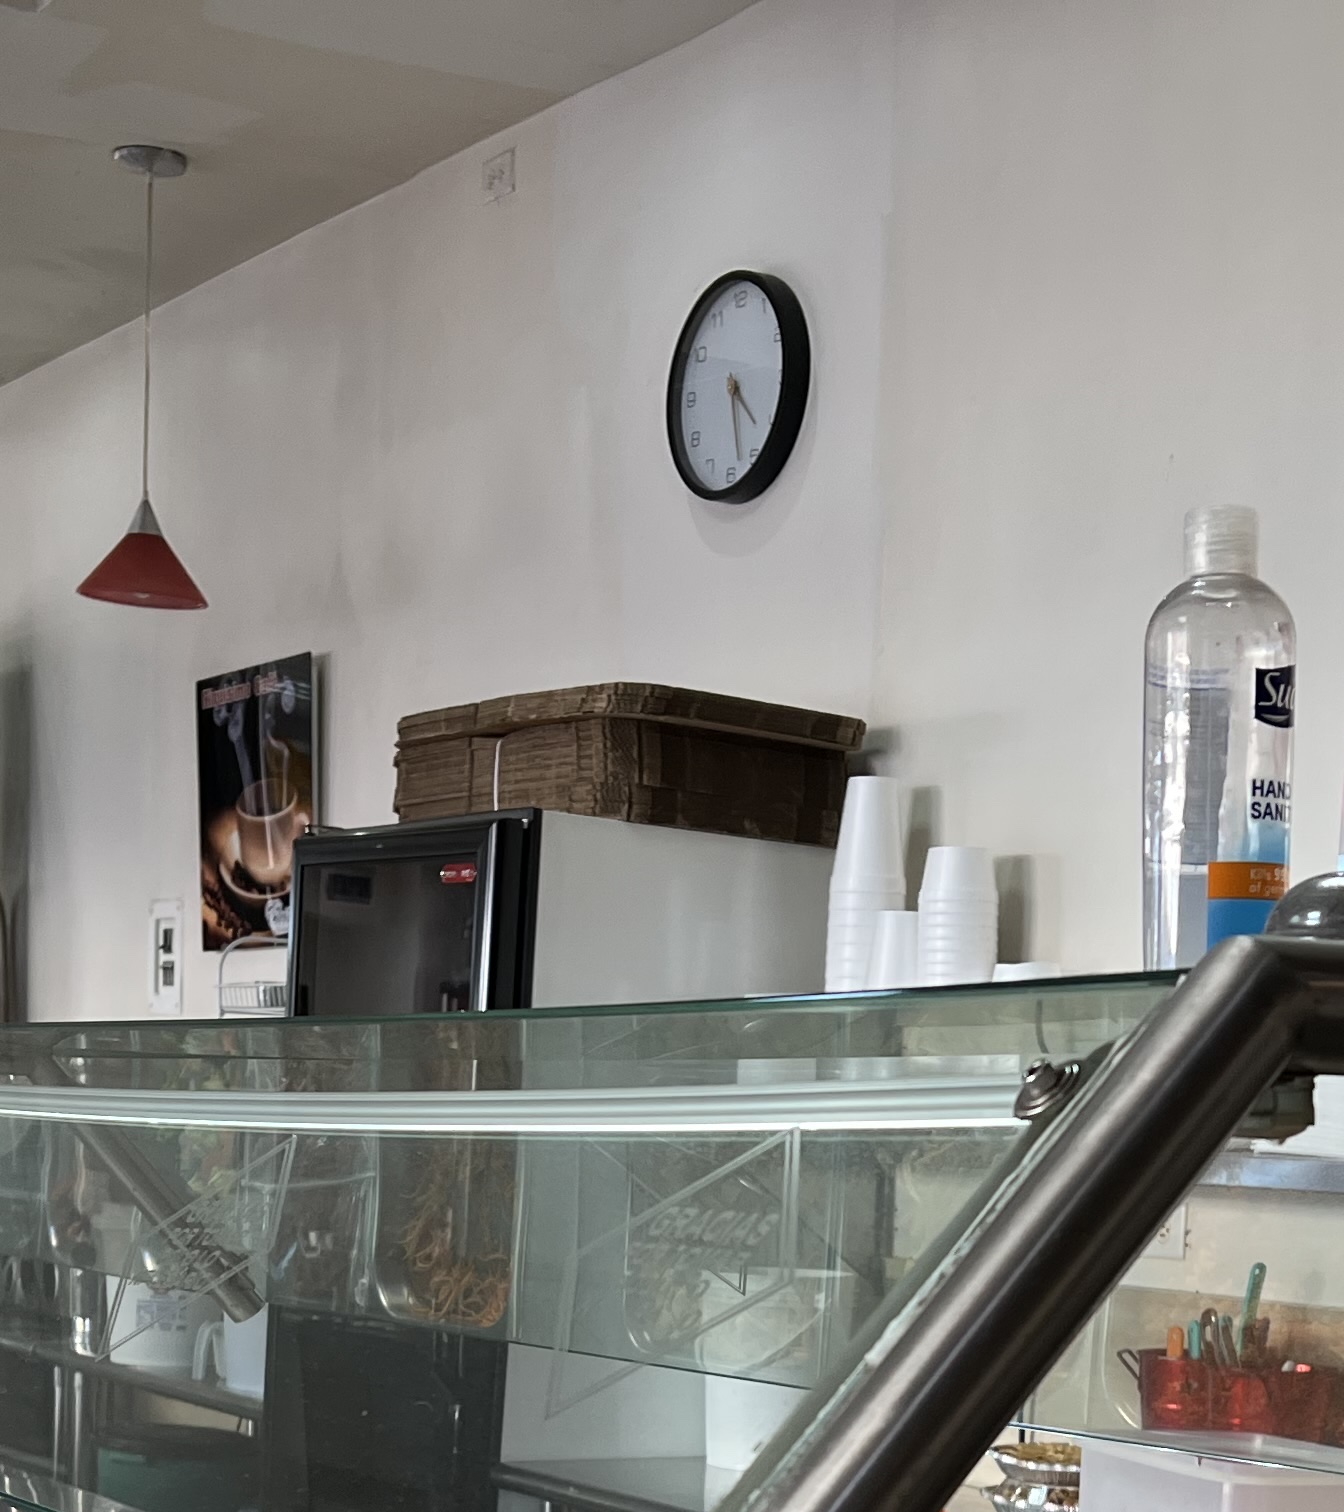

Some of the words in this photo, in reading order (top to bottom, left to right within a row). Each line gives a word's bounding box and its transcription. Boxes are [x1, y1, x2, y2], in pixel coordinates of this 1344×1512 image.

[686, 391, 696, 409] 9
[690, 431, 700, 447] 8
[706, 458, 715, 475] 7
[726, 466, 737, 484] 6
[1251, 778, 1292, 800] HAND
